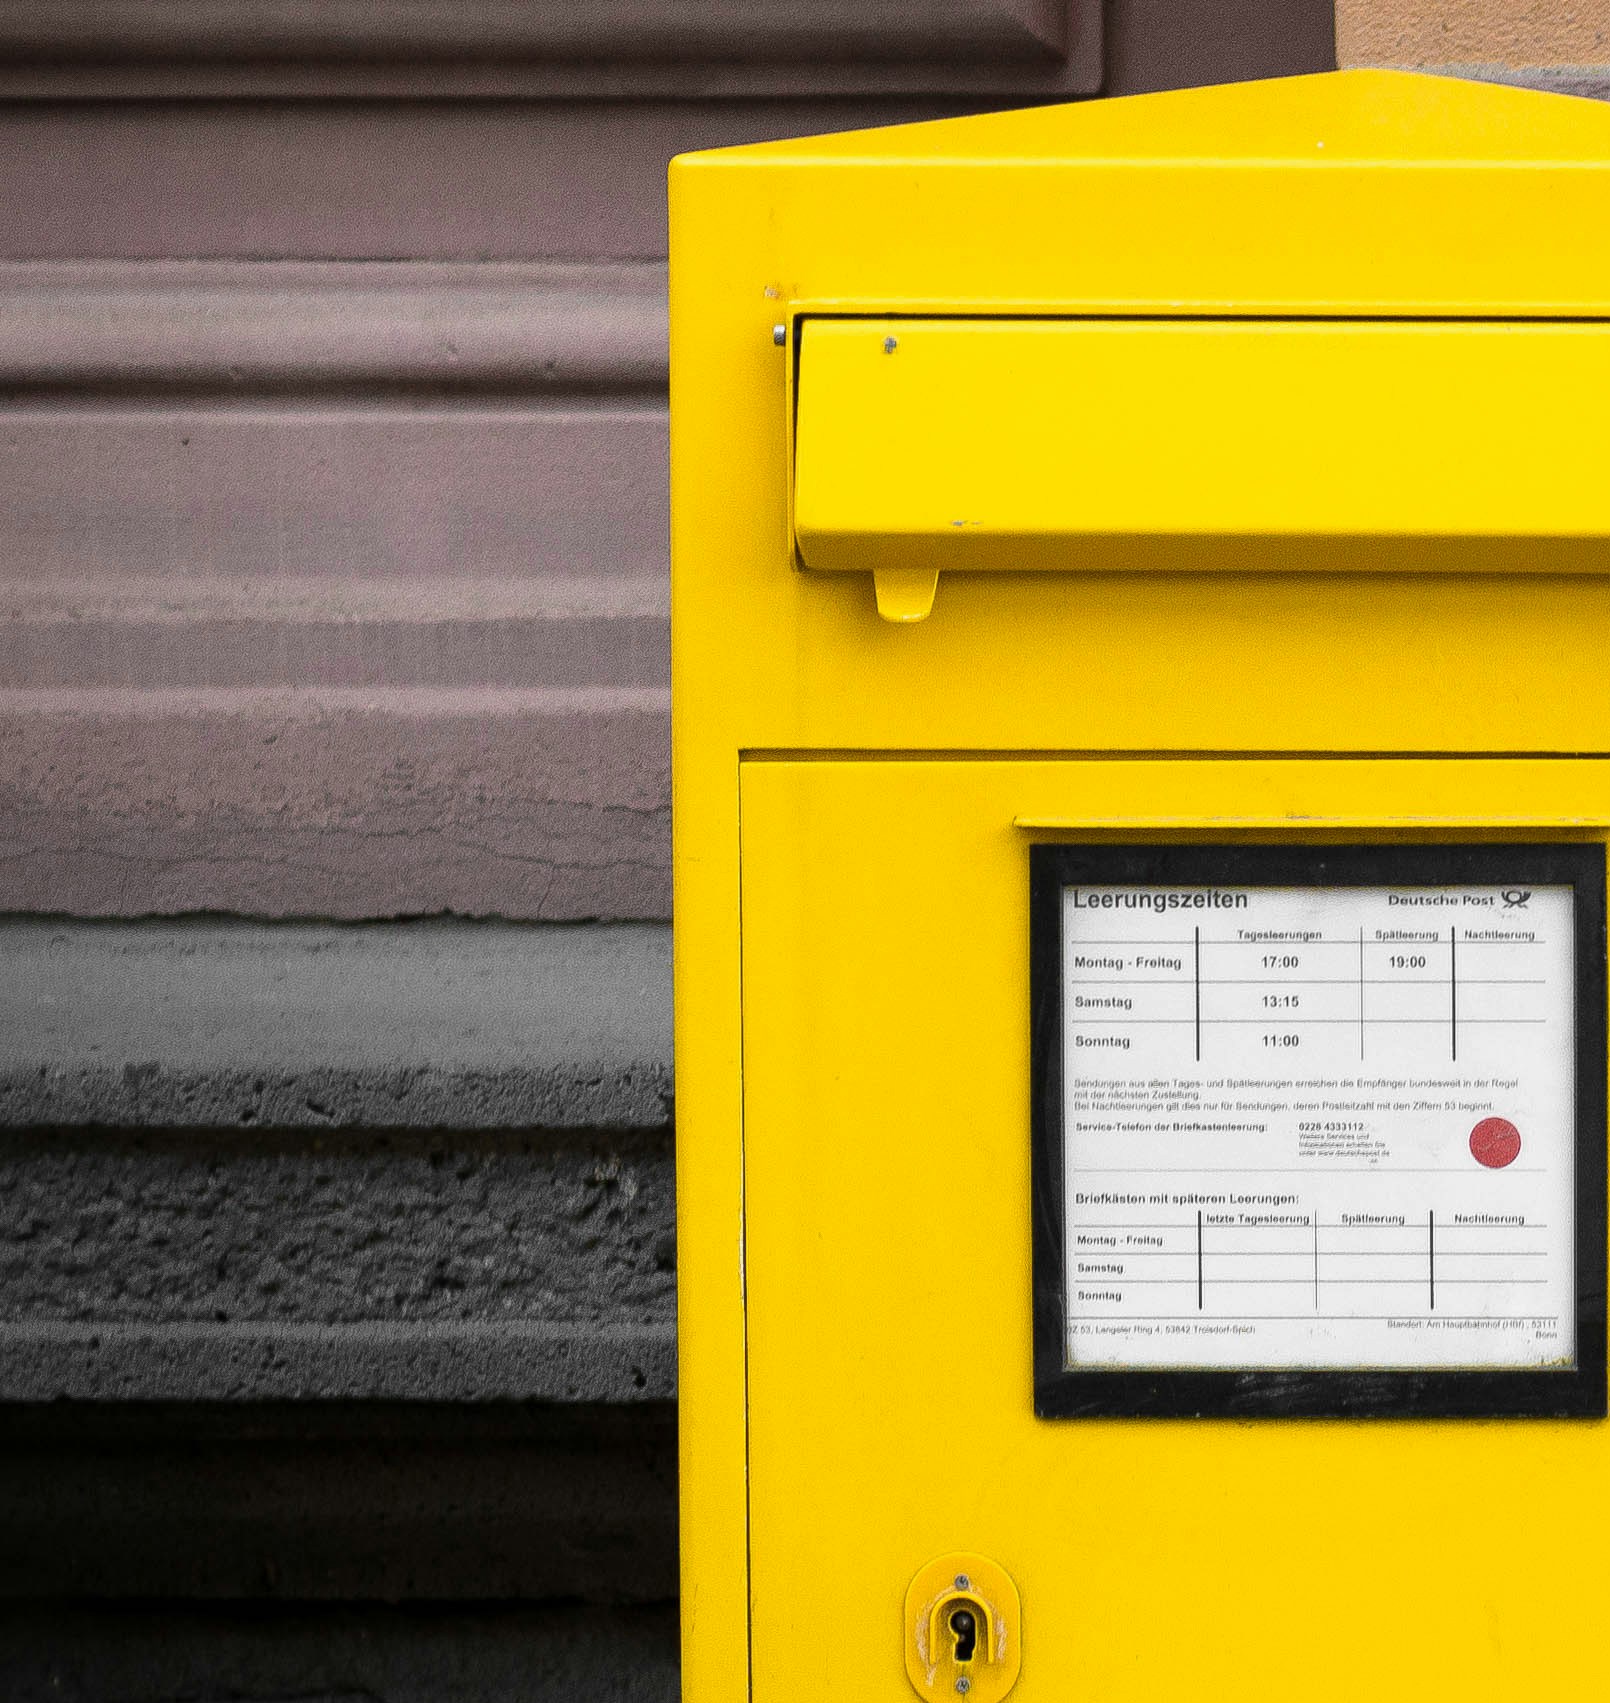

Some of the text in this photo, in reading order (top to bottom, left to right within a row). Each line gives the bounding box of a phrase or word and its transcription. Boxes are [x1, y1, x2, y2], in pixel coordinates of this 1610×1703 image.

[1073, 889, 1248, 913] Leerungszeiten
[1389, 895, 1495, 906] Deutsche Post
[1238, 930, 1321, 942] Tagesleerungen
[1376, 930, 1438, 942] Spätleerung
[1465, 930, 1535, 941] Nachtleerung
[1075, 957, 1123, 971] Montag
[1136, 957, 1181, 971] Freitag
[1262, 956, 1298, 968] 17:00
[1389, 956, 1426, 968] 19:00
[1075, 996, 1132, 1010] Samstag
[1263, 996, 1299, 1007] 13:15
[1076, 1036, 1130, 1049] Sonntag
[1263, 1036, 1299, 1047] 11:00
[1075, 1079, 1126, 1088] Sendungen
[1148, 1079, 1169, 1088] allen
[1173, 1079, 1204, 1089] Tages-
[1207, 1080, 1223, 1088] und
[1227, 1079, 1292, 1089] Spätleerungen
[1295, 1079, 1337, 1088] erreichen
[1340, 1079, 1353, 1088] die
[1357, 1079, 1406, 1090] Empfänger
[1410, 1079, 1460, 1088] bundesweit
[1464, 1079, 1471, 1088] in
[1474, 1079, 1488, 1088] der
[1492, 1079, 1518, 1089] Regel
[1074, 1091, 1087, 1099] mit
[1091, 1091, 1105, 1099] der
[1108, 1091, 1149, 1099] nächsten
[1075, 1102, 1089, 1110] Bei
[1092, 1102, 1163, 1112] Nachtleerungen
[1166, 1102, 1179, 1112] gilt
[1182, 1102, 1200, 1110] dies
[1221, 1102, 1233, 1110] für
[1322, 1102, 1374, 1110] Postleitzahl
[1377, 1102, 1390, 1110] mit
[1393, 1102, 1410, 1110] den
[1413, 1102, 1442, 1110] Ziffern
[1445, 1102, 1456, 1110] 53
[1076, 1123, 1364, 1133] Service-Telefon der Briefkastenleerung: 0228 4333112
[1076, 1194, 1299, 1205] Briefkästen mit späteren Leerungen:
[1207, 1215, 1310, 1225] letzte Tagesleerung
[1342, 1214, 1405, 1225] Spätleerung
[1455, 1214, 1524, 1225] Nachtleerung
[1078, 1236, 1116, 1246] Montag
[1127, 1236, 1163, 1246] Freitag
[1078, 1264, 1123, 1274] Samstag
[1079, 1292, 1121, 1302] Sonntag
